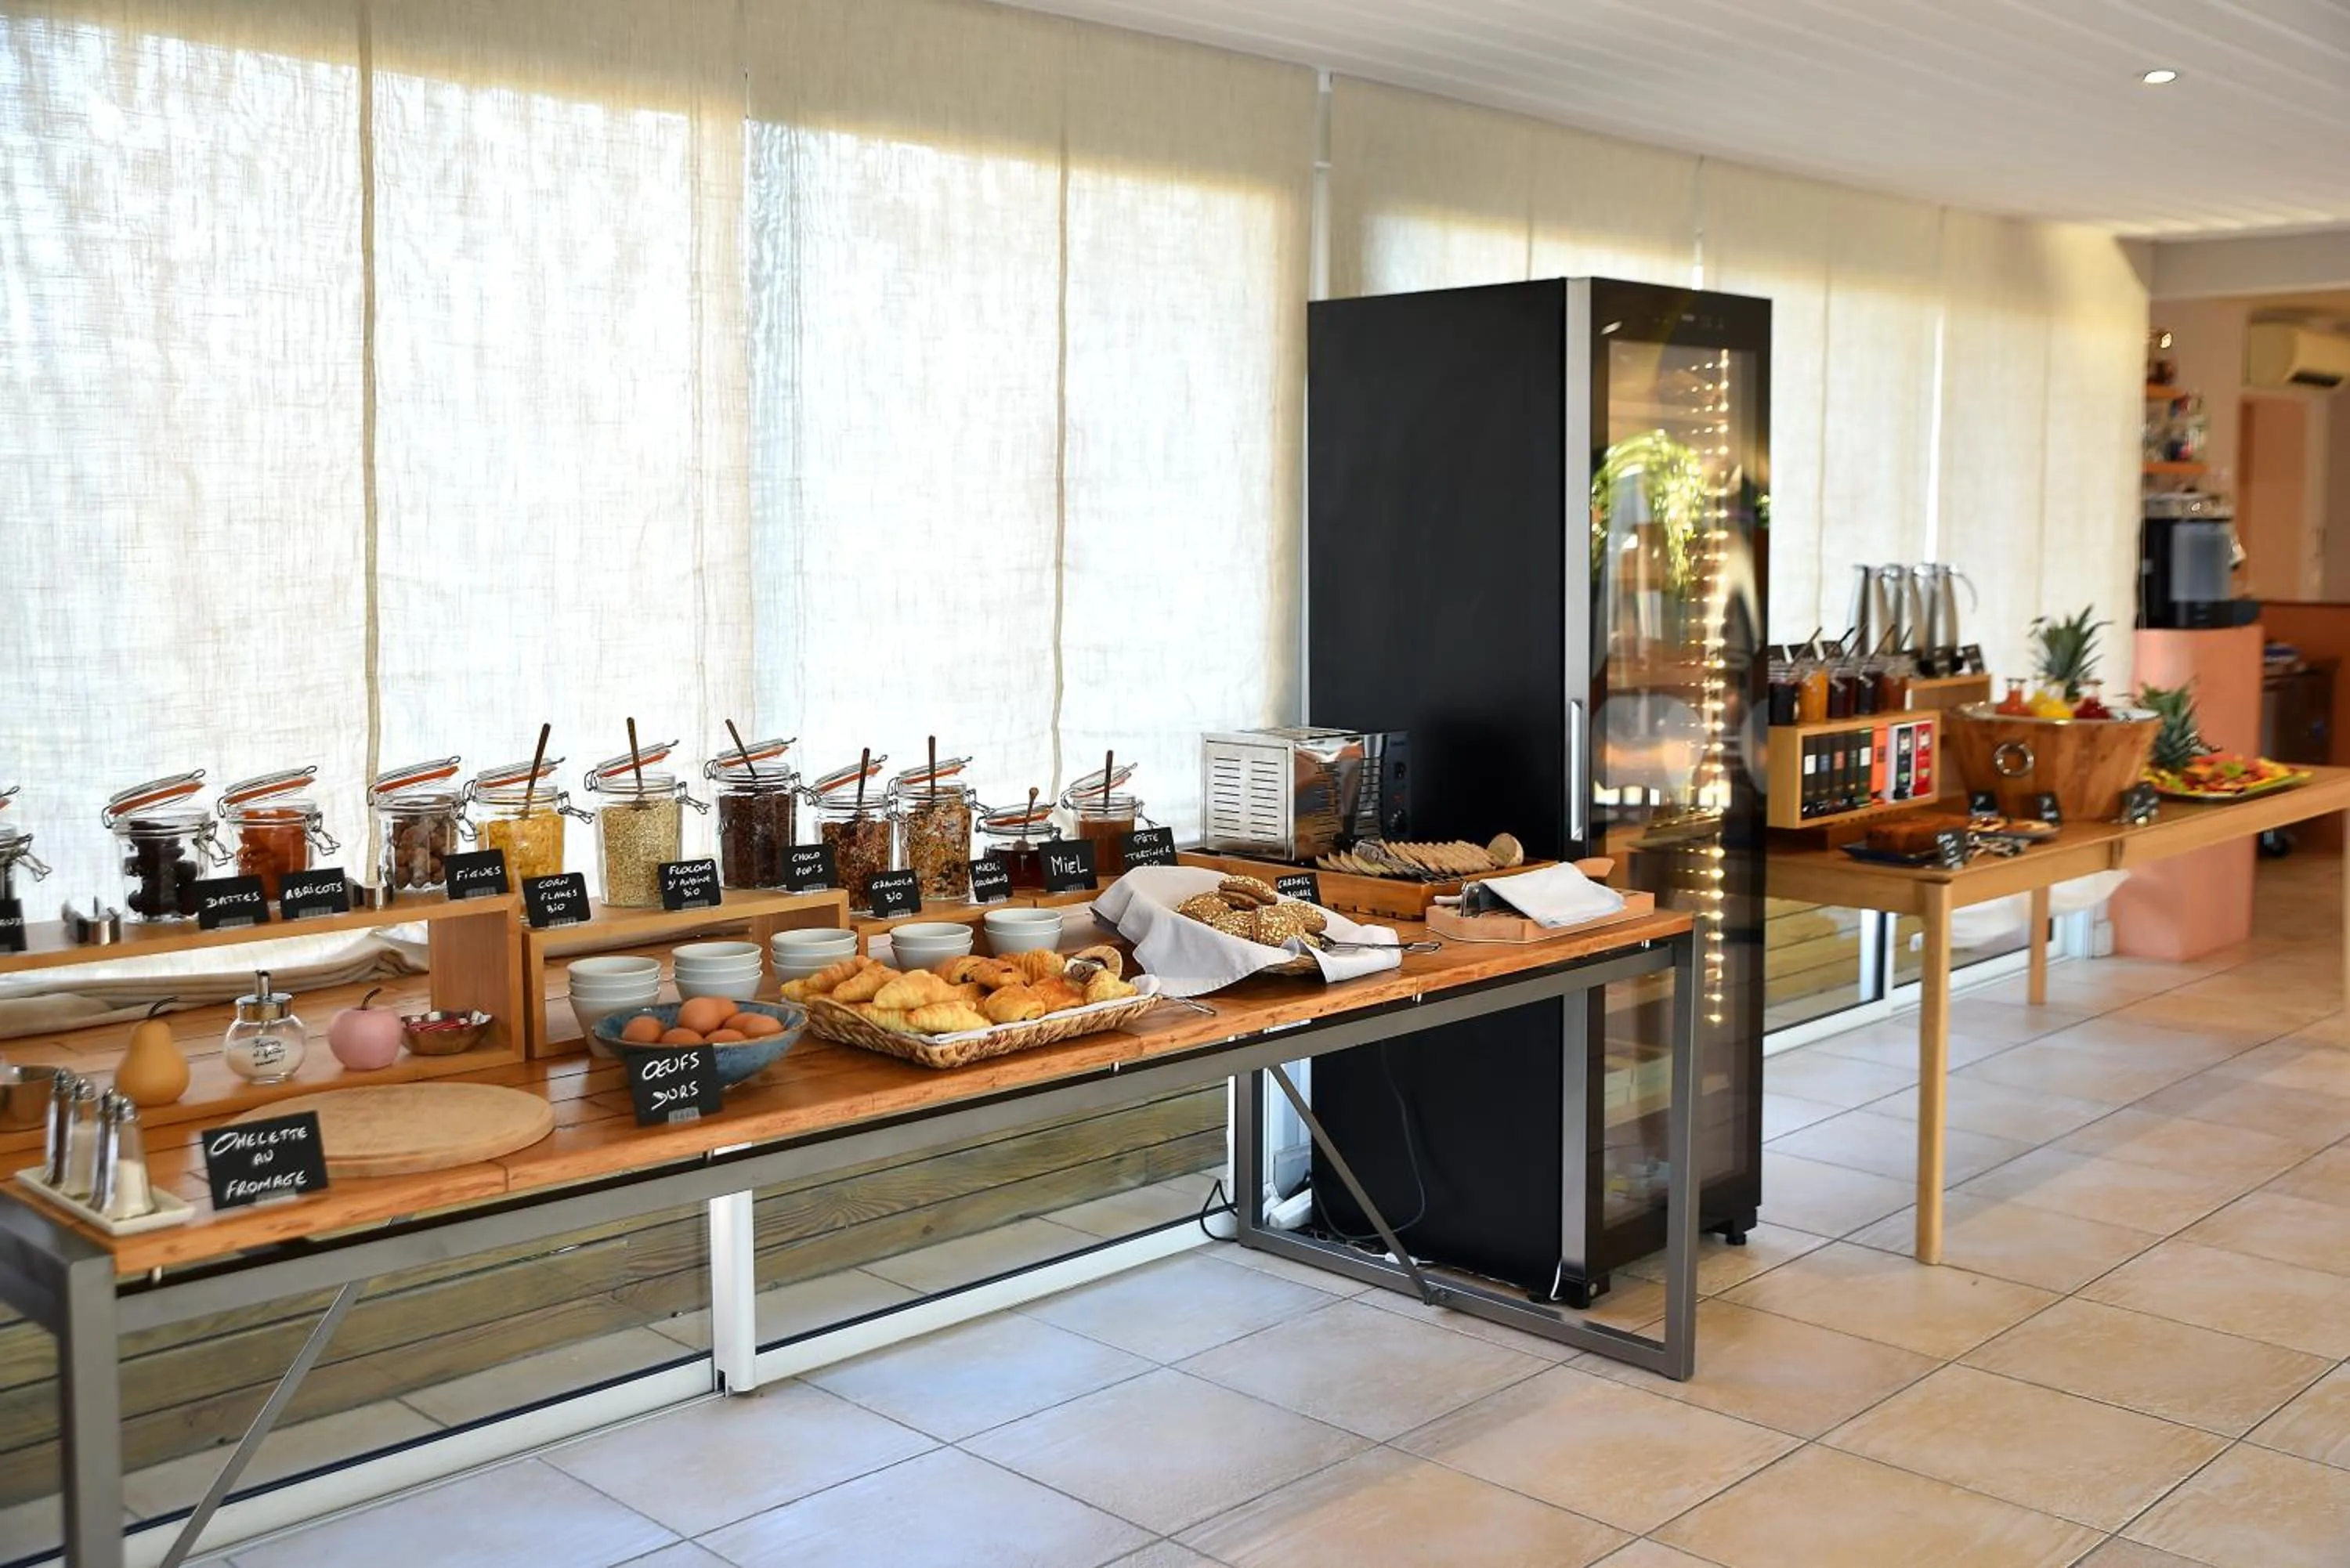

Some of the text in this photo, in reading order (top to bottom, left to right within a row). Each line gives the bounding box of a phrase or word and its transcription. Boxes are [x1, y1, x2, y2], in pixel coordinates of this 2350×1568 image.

[538, 878, 569, 889] CORN
[872, 877, 913, 890] GRANOLA
[207, 891, 260, 908] DATTES
[651, 1081, 700, 1111] DURS
[210, 1126, 308, 1156] OMELETTE
[252, 1149, 274, 1166] AU
[225, 1170, 308, 1201] FROMAGE
